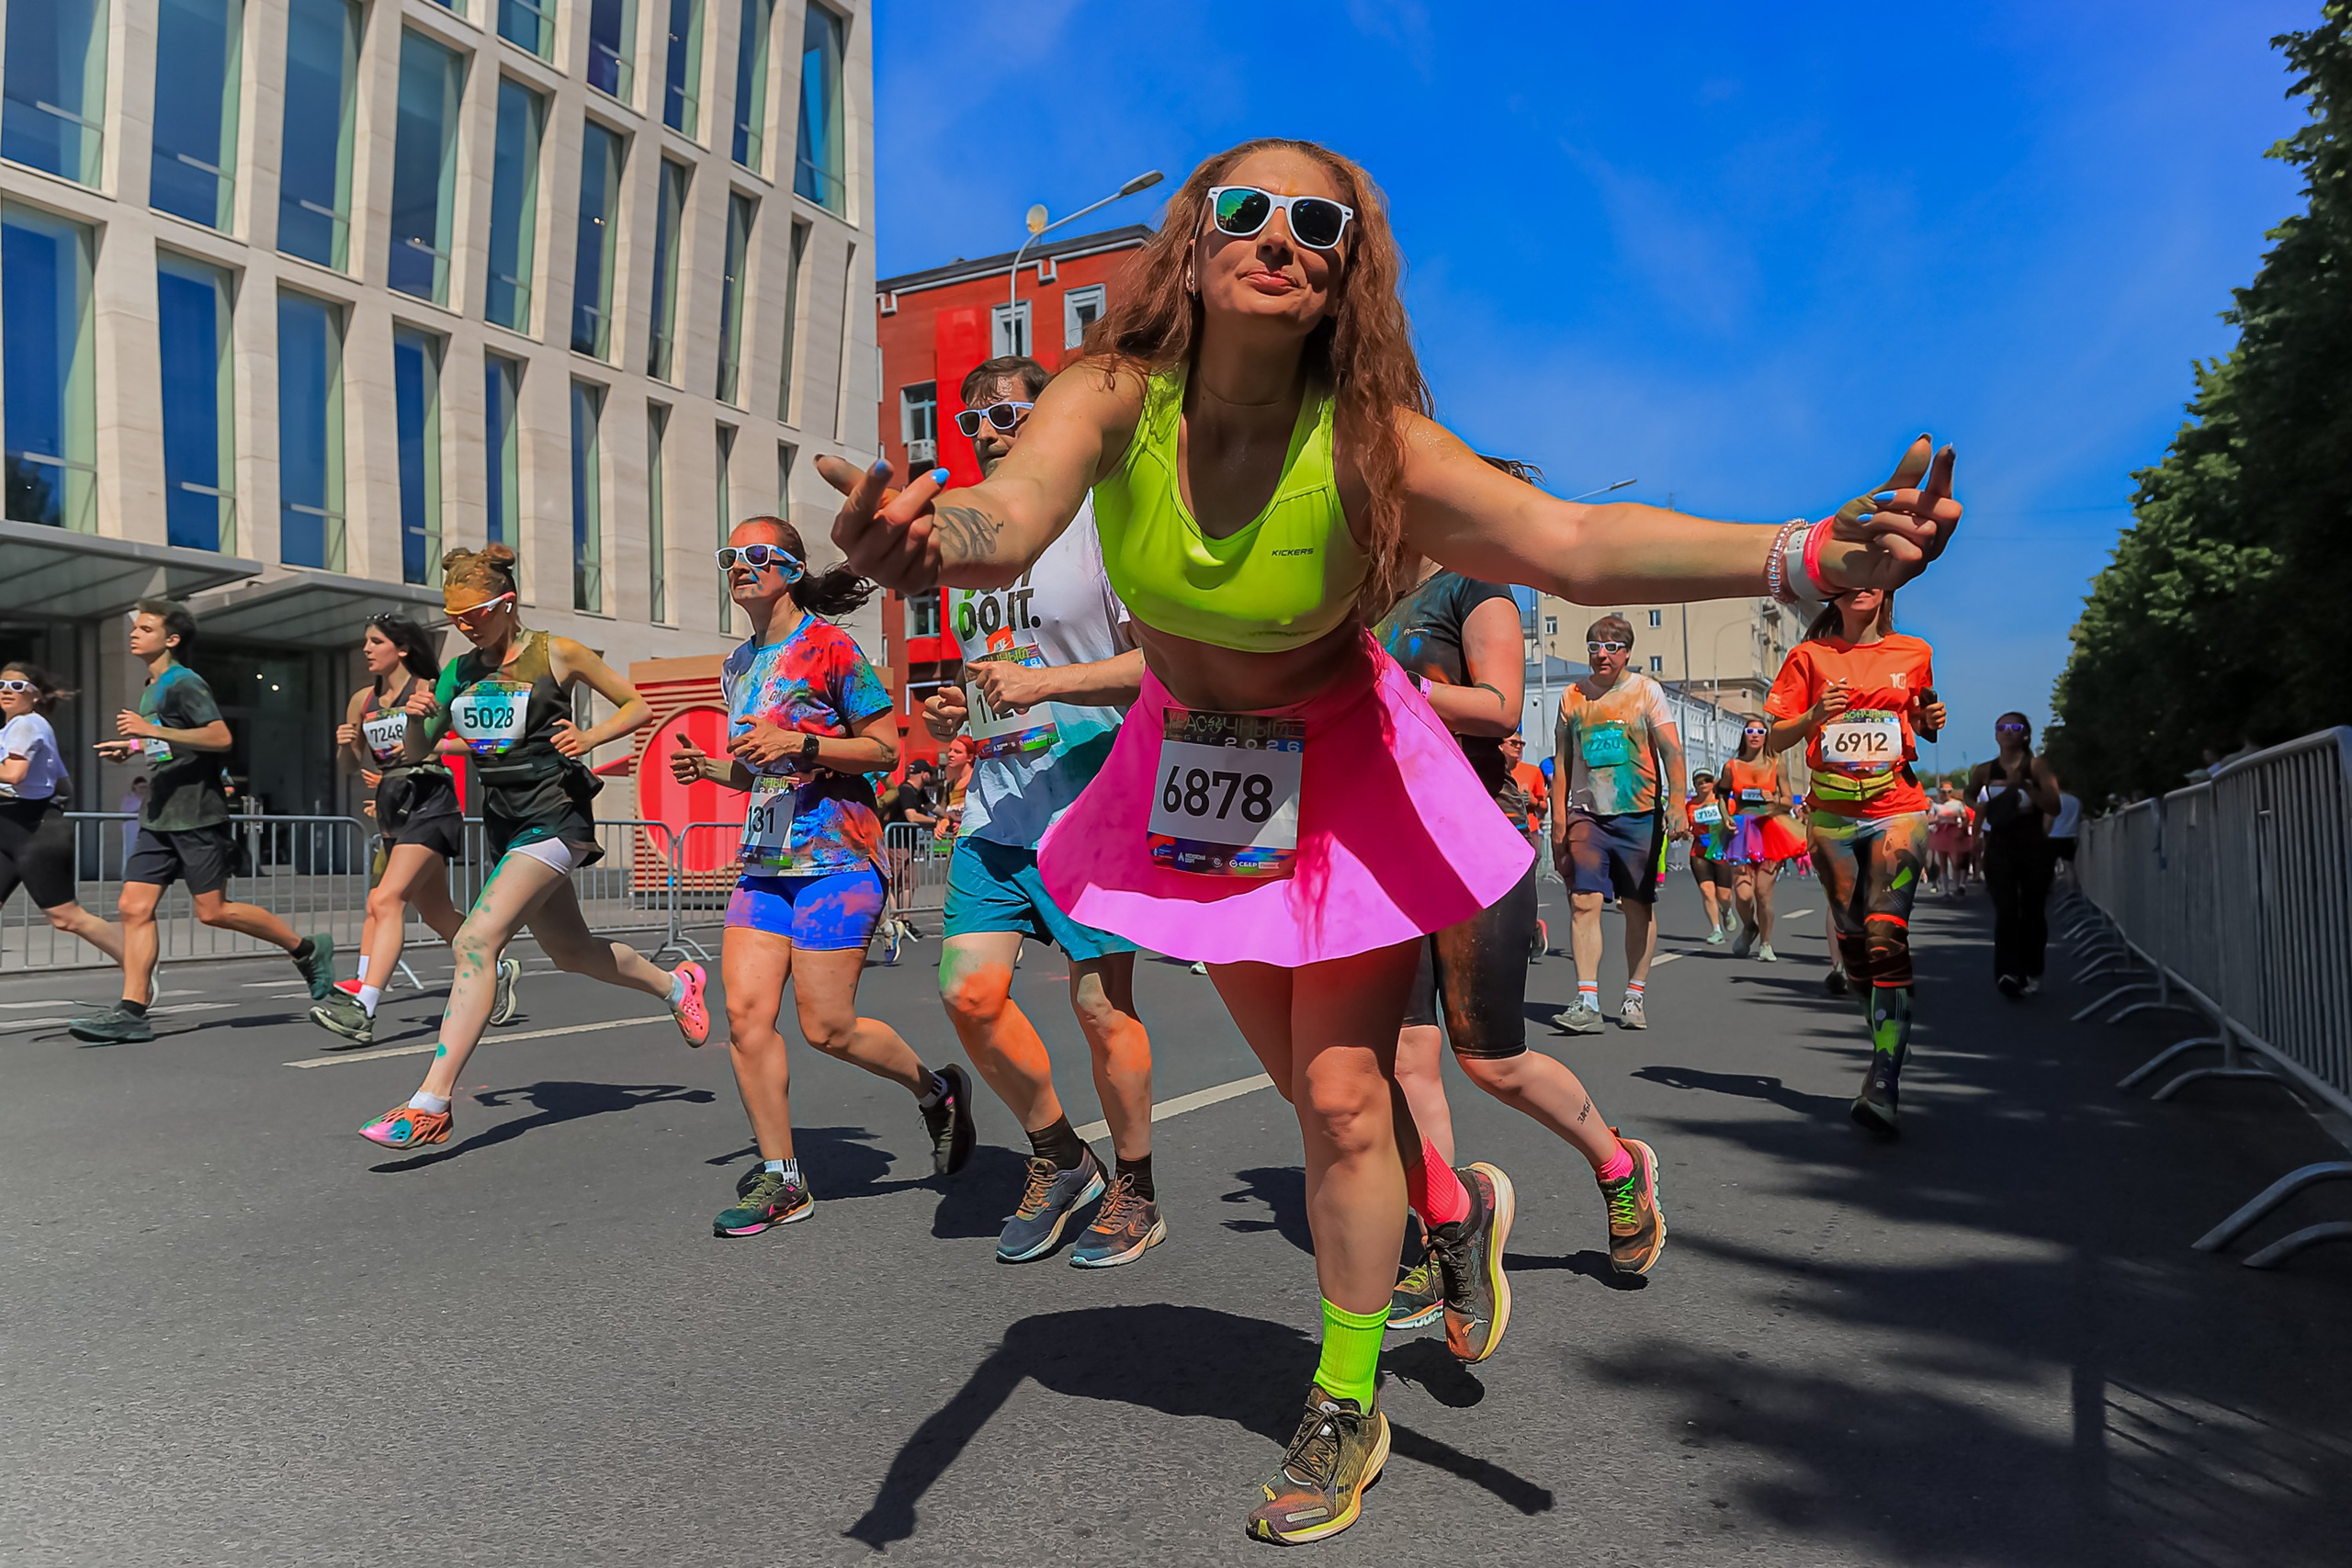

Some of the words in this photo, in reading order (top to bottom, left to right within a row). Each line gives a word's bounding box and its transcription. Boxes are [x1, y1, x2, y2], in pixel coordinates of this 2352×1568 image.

[958, 596, 1001, 641] DO
[1007, 588, 1041, 631] IT.
[463, 706, 514, 728] 5028
[370, 724, 402, 743] 7248
[1835, 731, 1889, 752] 6912
[1225, 738, 1300, 752] 2026
[1163, 765, 1273, 823] 6878
[743, 805, 775, 834] 131
